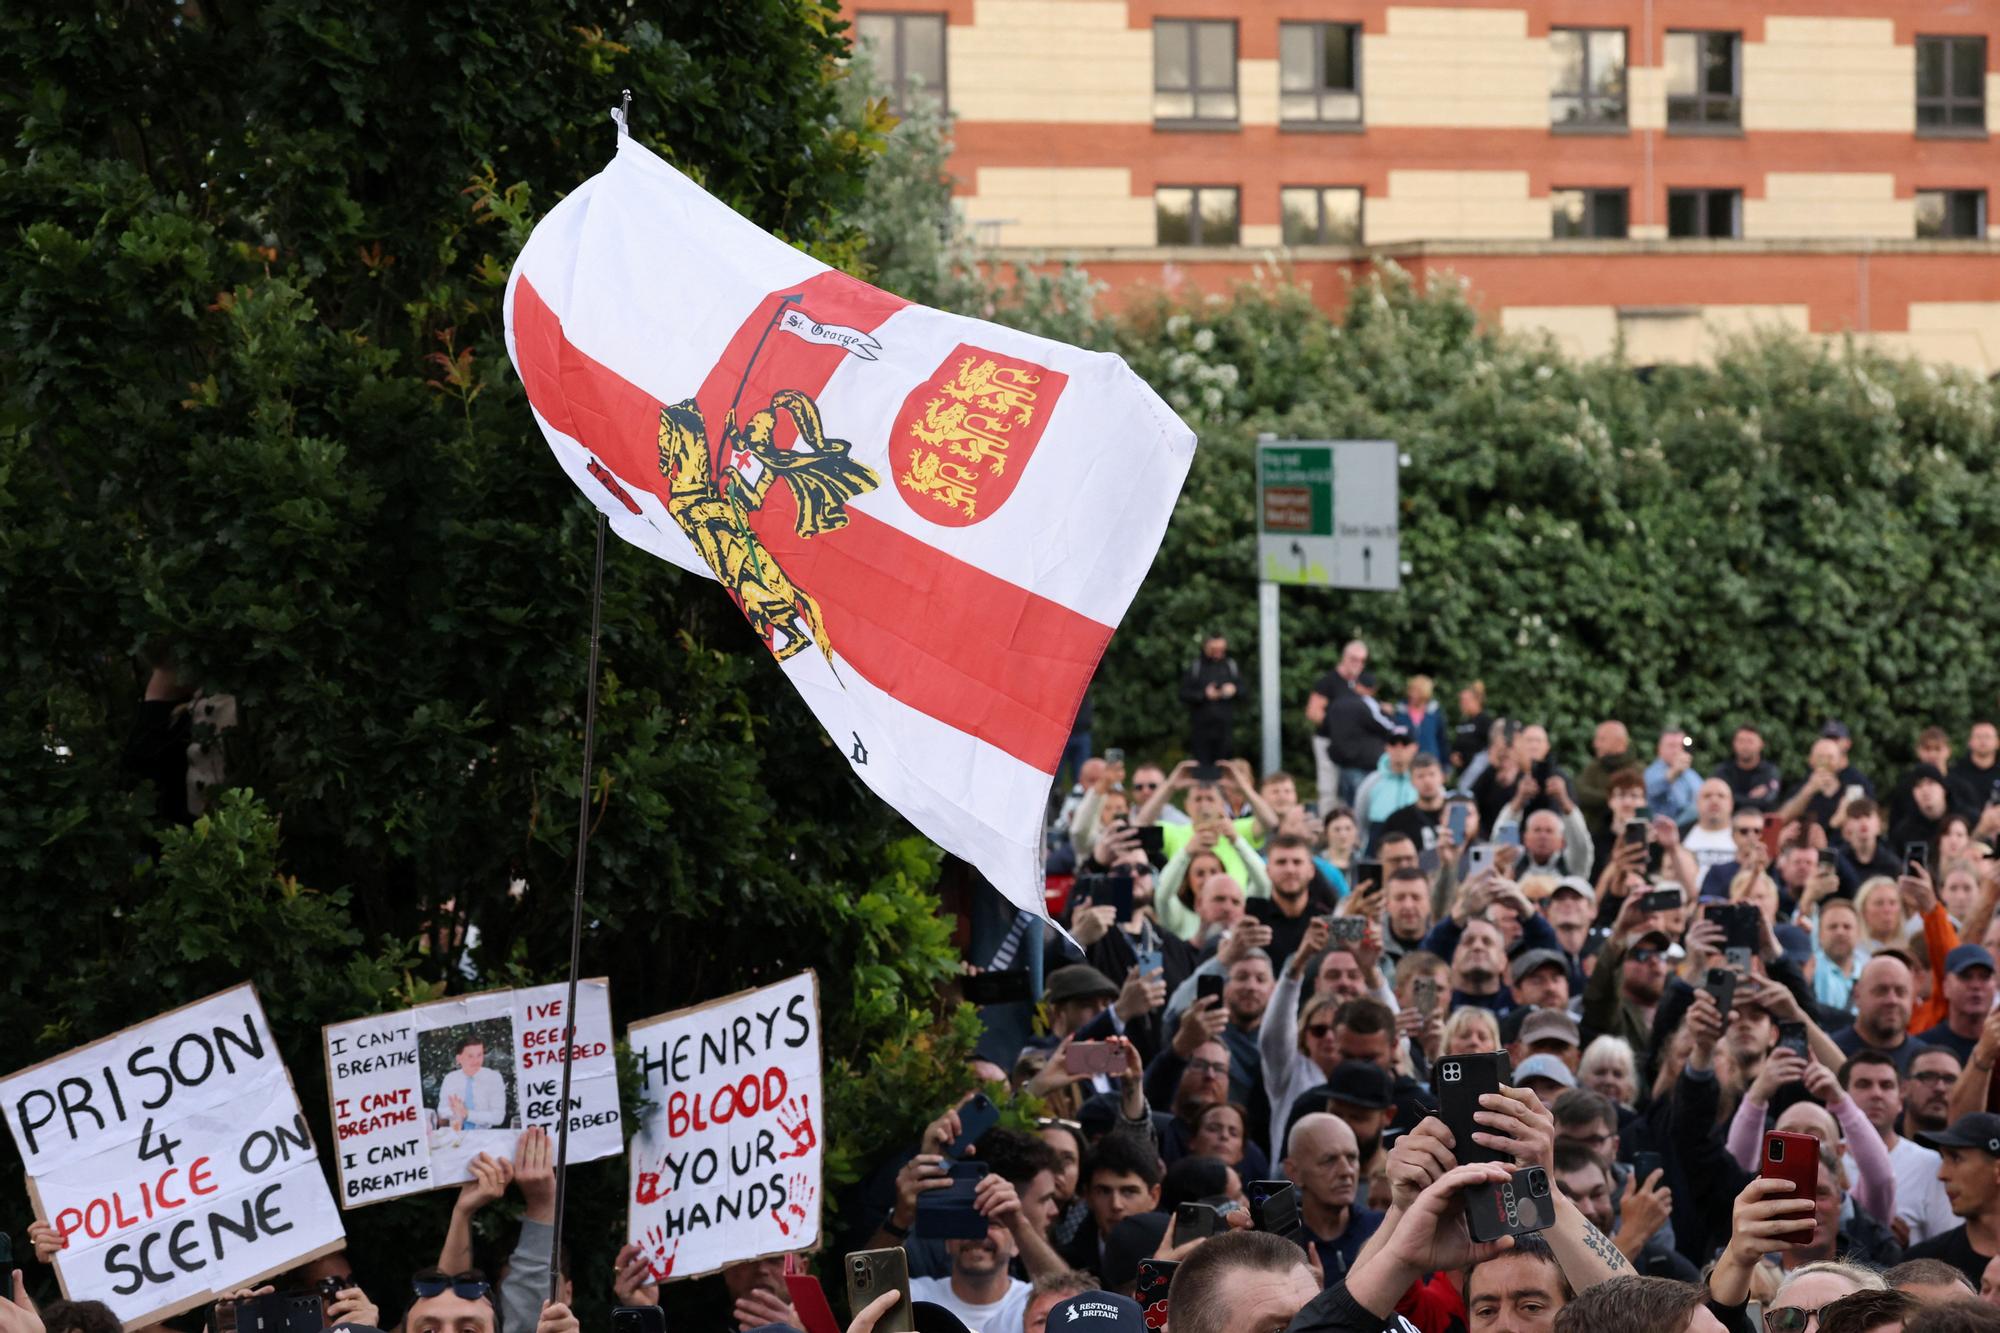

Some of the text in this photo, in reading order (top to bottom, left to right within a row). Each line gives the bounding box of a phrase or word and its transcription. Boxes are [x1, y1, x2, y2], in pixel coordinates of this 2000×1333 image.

[785, 314, 860, 347] St. George
[527, 1000, 562, 1021] IVE
[331, 1028, 410, 1056] I CANT
[642, 995, 809, 1091] HENRYS
[337, 1049, 417, 1079] BREATHE
[17, 1014, 264, 1155] PRISON
[527, 1080, 557, 1097] IVE
[336, 1089, 411, 1119] I CANT
[668, 1067, 788, 1138] BLOOD
[338, 1106, 417, 1140] BREATHE
[527, 1110, 619, 1136] TBBED
[138, 1117, 182, 1166] 4
[343, 1139, 419, 1170] I CANT
[664, 1129, 777, 1191] YOUR
[55, 1114, 312, 1249] POLICE ON
[347, 1166, 428, 1197] BREATHE
[665, 1173, 787, 1239] HANDS
[104, 1183, 293, 1296] SCENE
[1079, 1302, 1119, 1314] RESTORE
[1082, 1310, 1118, 1320] BRITAIN
